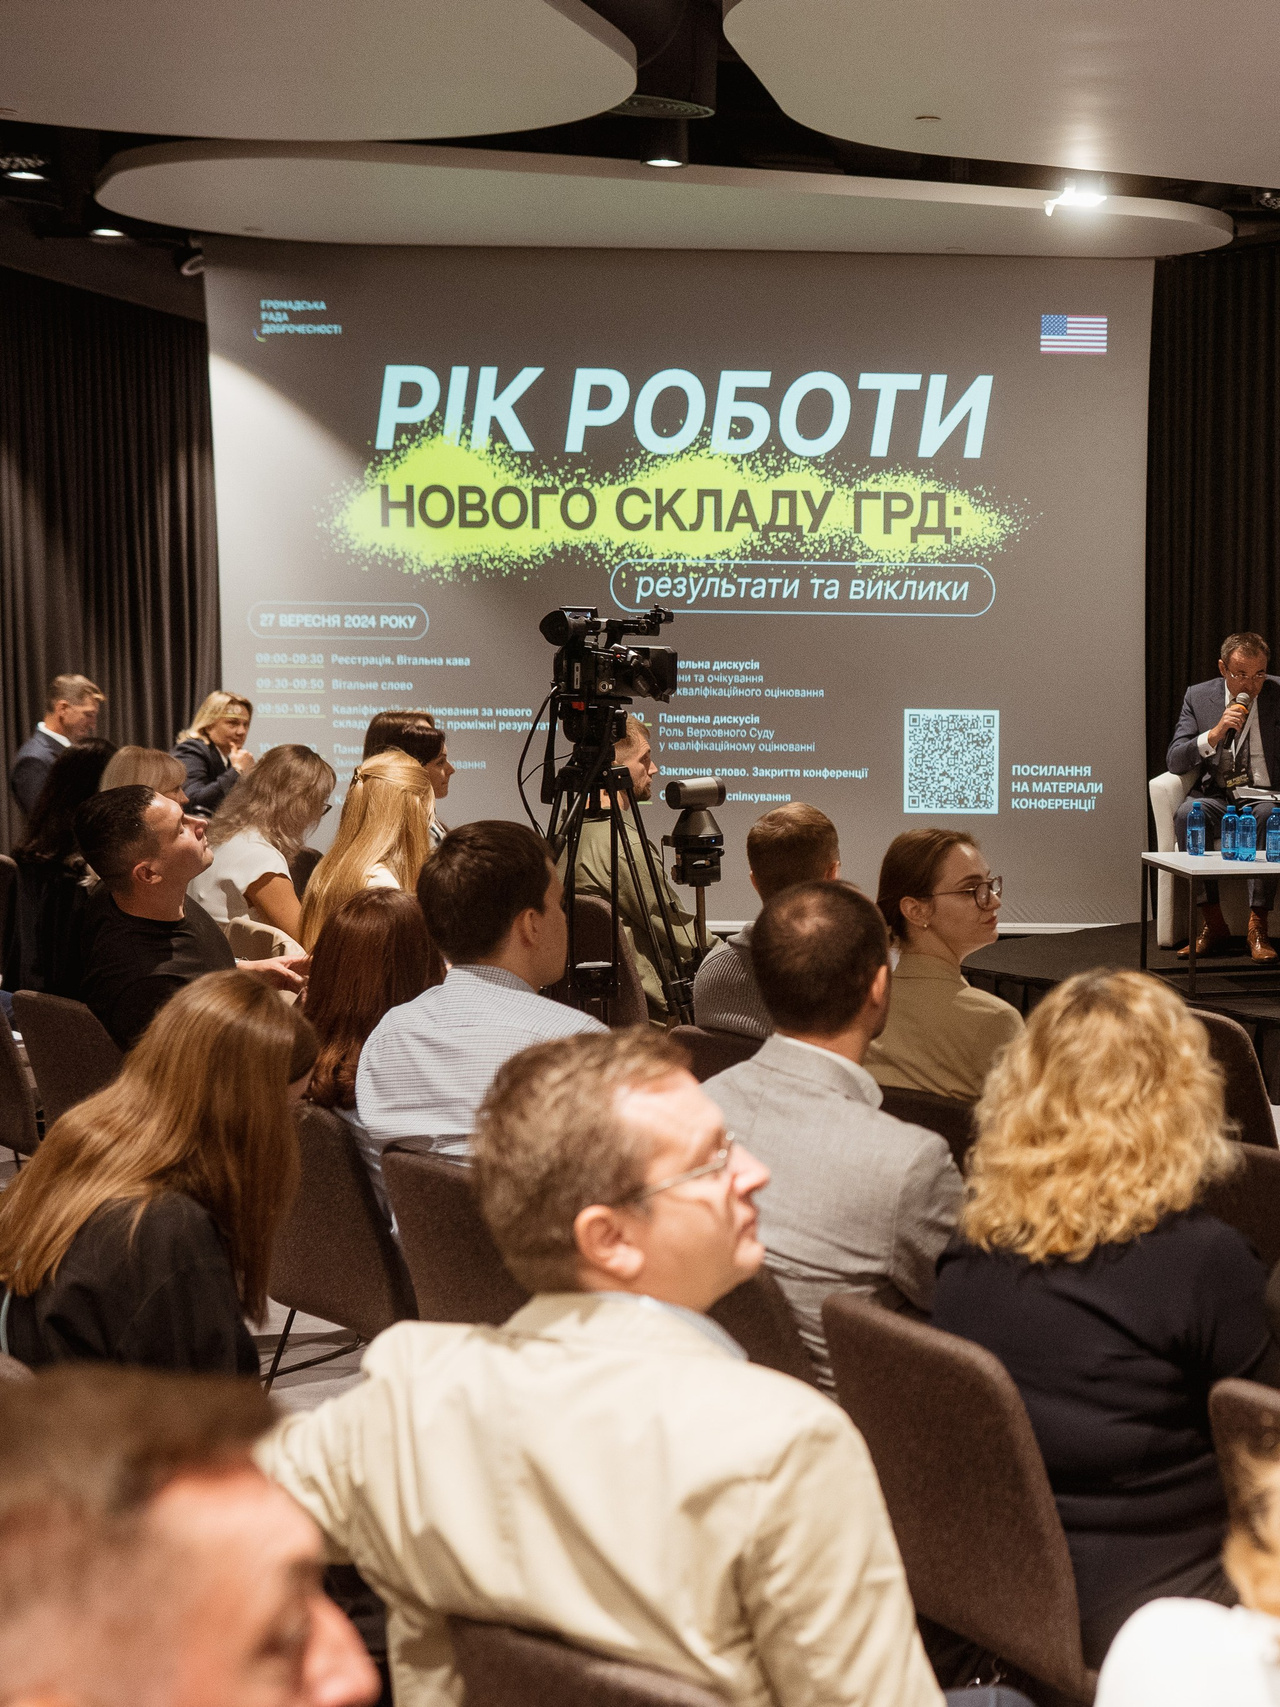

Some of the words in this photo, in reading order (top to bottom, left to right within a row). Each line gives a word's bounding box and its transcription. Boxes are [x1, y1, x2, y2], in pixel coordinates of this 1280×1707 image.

[261, 311, 289, 323] РАДА
[375, 364, 545, 453] РІК
[564, 367, 994, 459] РОБОТИ
[380, 484, 598, 531] НОВОГО
[614, 486, 836, 539] СКЛАДУ
[854, 491, 963, 544] ГРД:
[635, 573, 799, 605] результати
[810, 576, 840, 600] та
[848, 578, 970, 602] виклики
[259, 613, 275, 628] 27
[279, 613, 341, 628] ВЕРЕСНЯ
[344, 614, 377, 628] 2024
[380, 615, 417, 629] РОКУ
[397, 654, 444, 666] Вітальна
[446, 656, 471, 667] кава
[712, 659, 760, 671] дискусія
[331, 679, 379, 691] Вітальне
[381, 680, 413, 691] слово
[694, 674, 705, 683] та
[707, 673, 764, 684] очікування
[677, 686, 762, 698] кваліфікаційного
[765, 687, 825, 698] оцінювання
[481, 706, 494, 717] за
[495, 707, 533, 718] нового
[659, 712, 711, 724] Панельна
[712, 713, 760, 725] дискусія
[446, 719, 497, 731] проміжні
[659, 727, 684, 738] Роль
[686, 727, 747, 739] Верховного
[749, 728, 775, 740] Суду
[659, 741, 666, 751] у
[668, 740, 756, 752] кваліфікаційному
[758, 741, 816, 752] оцінюванні
[659, 765, 712, 777] Заключне
[715, 767, 749, 777] слово.
[752, 767, 801, 777] Закриття
[803, 767, 869, 780] конференції
[1012, 764, 1092, 777] ПОСИЛАННЯ
[1012, 780, 1030, 792] НА
[1032, 781, 1103, 794] МАТЕРІАЛИ
[1011, 796, 1096, 811] КОНФЕРЕНЦІЇ
